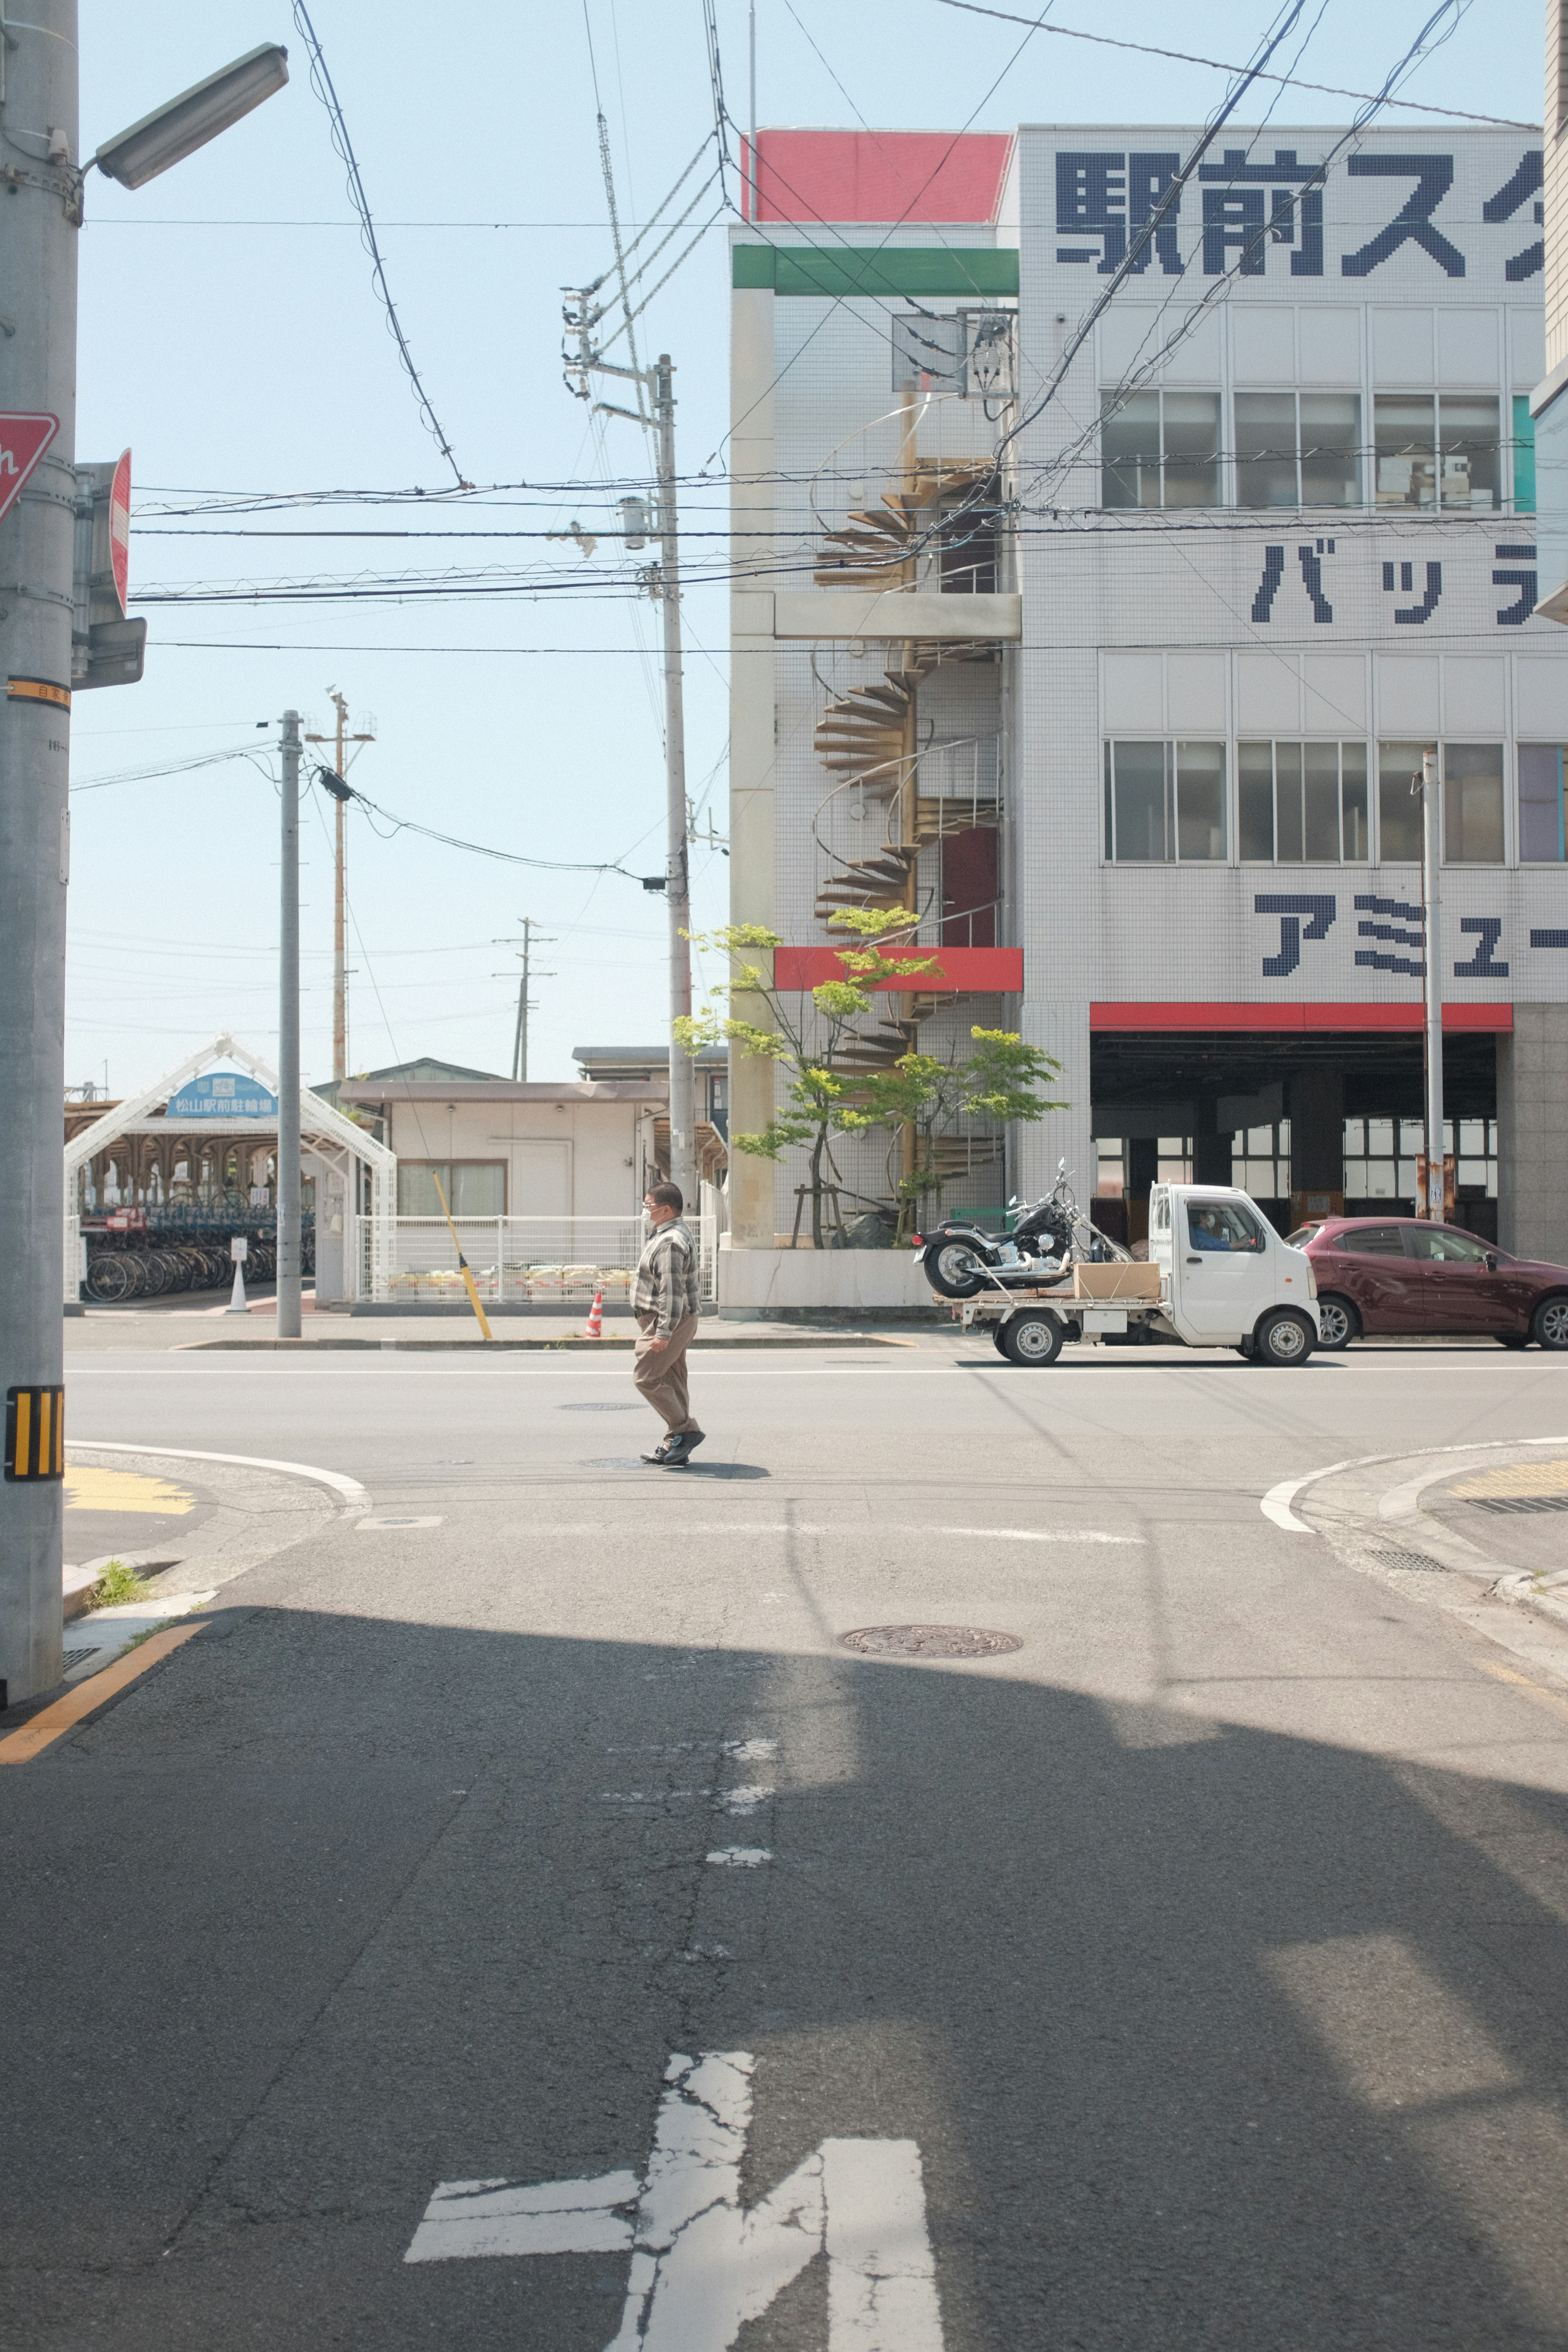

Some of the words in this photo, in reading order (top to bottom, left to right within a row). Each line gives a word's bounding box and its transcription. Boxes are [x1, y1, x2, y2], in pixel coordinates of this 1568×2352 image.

[175, 1098, 272, 1113] 松山駅前駐輪場
